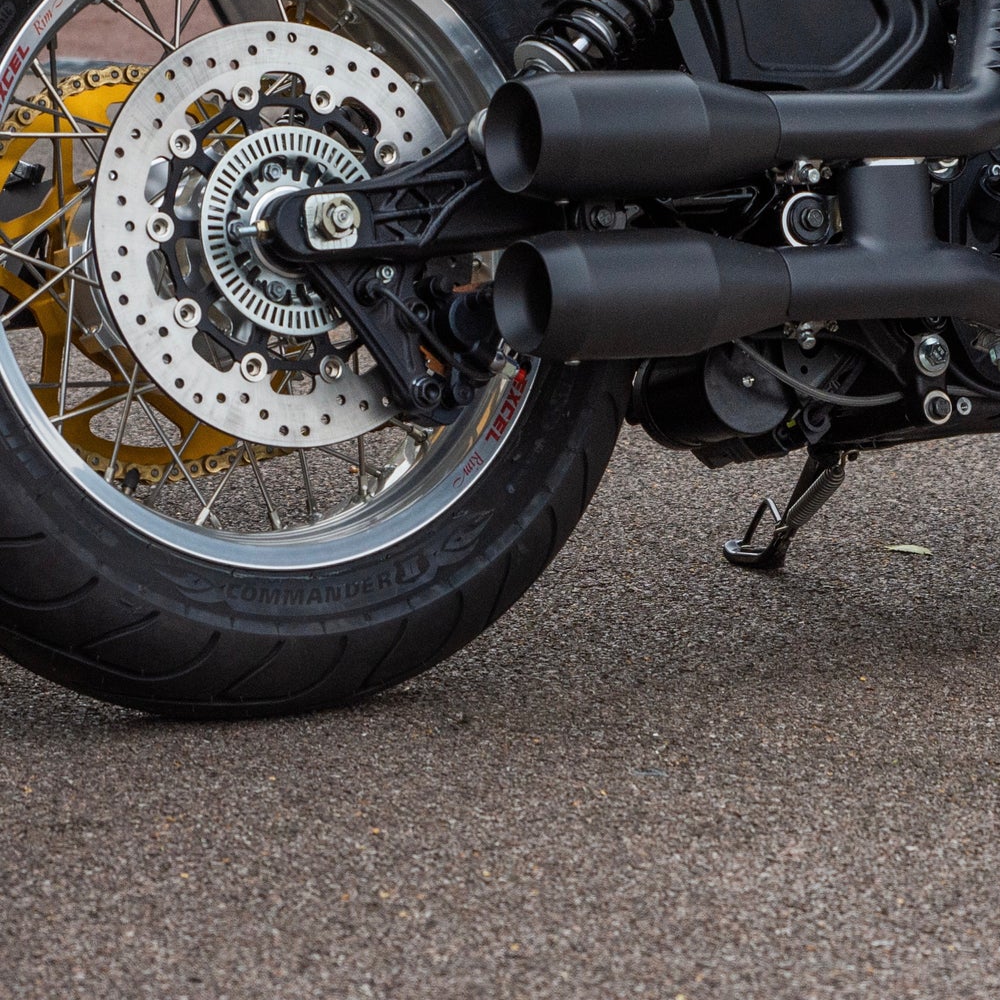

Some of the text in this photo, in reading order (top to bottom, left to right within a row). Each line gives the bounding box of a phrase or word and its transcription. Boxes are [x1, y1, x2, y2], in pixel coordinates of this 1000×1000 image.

[0, 45, 30, 110] XCEL
[485, 376, 527, 442] EXCEL
[224, 571, 392, 606] COMMANDER
